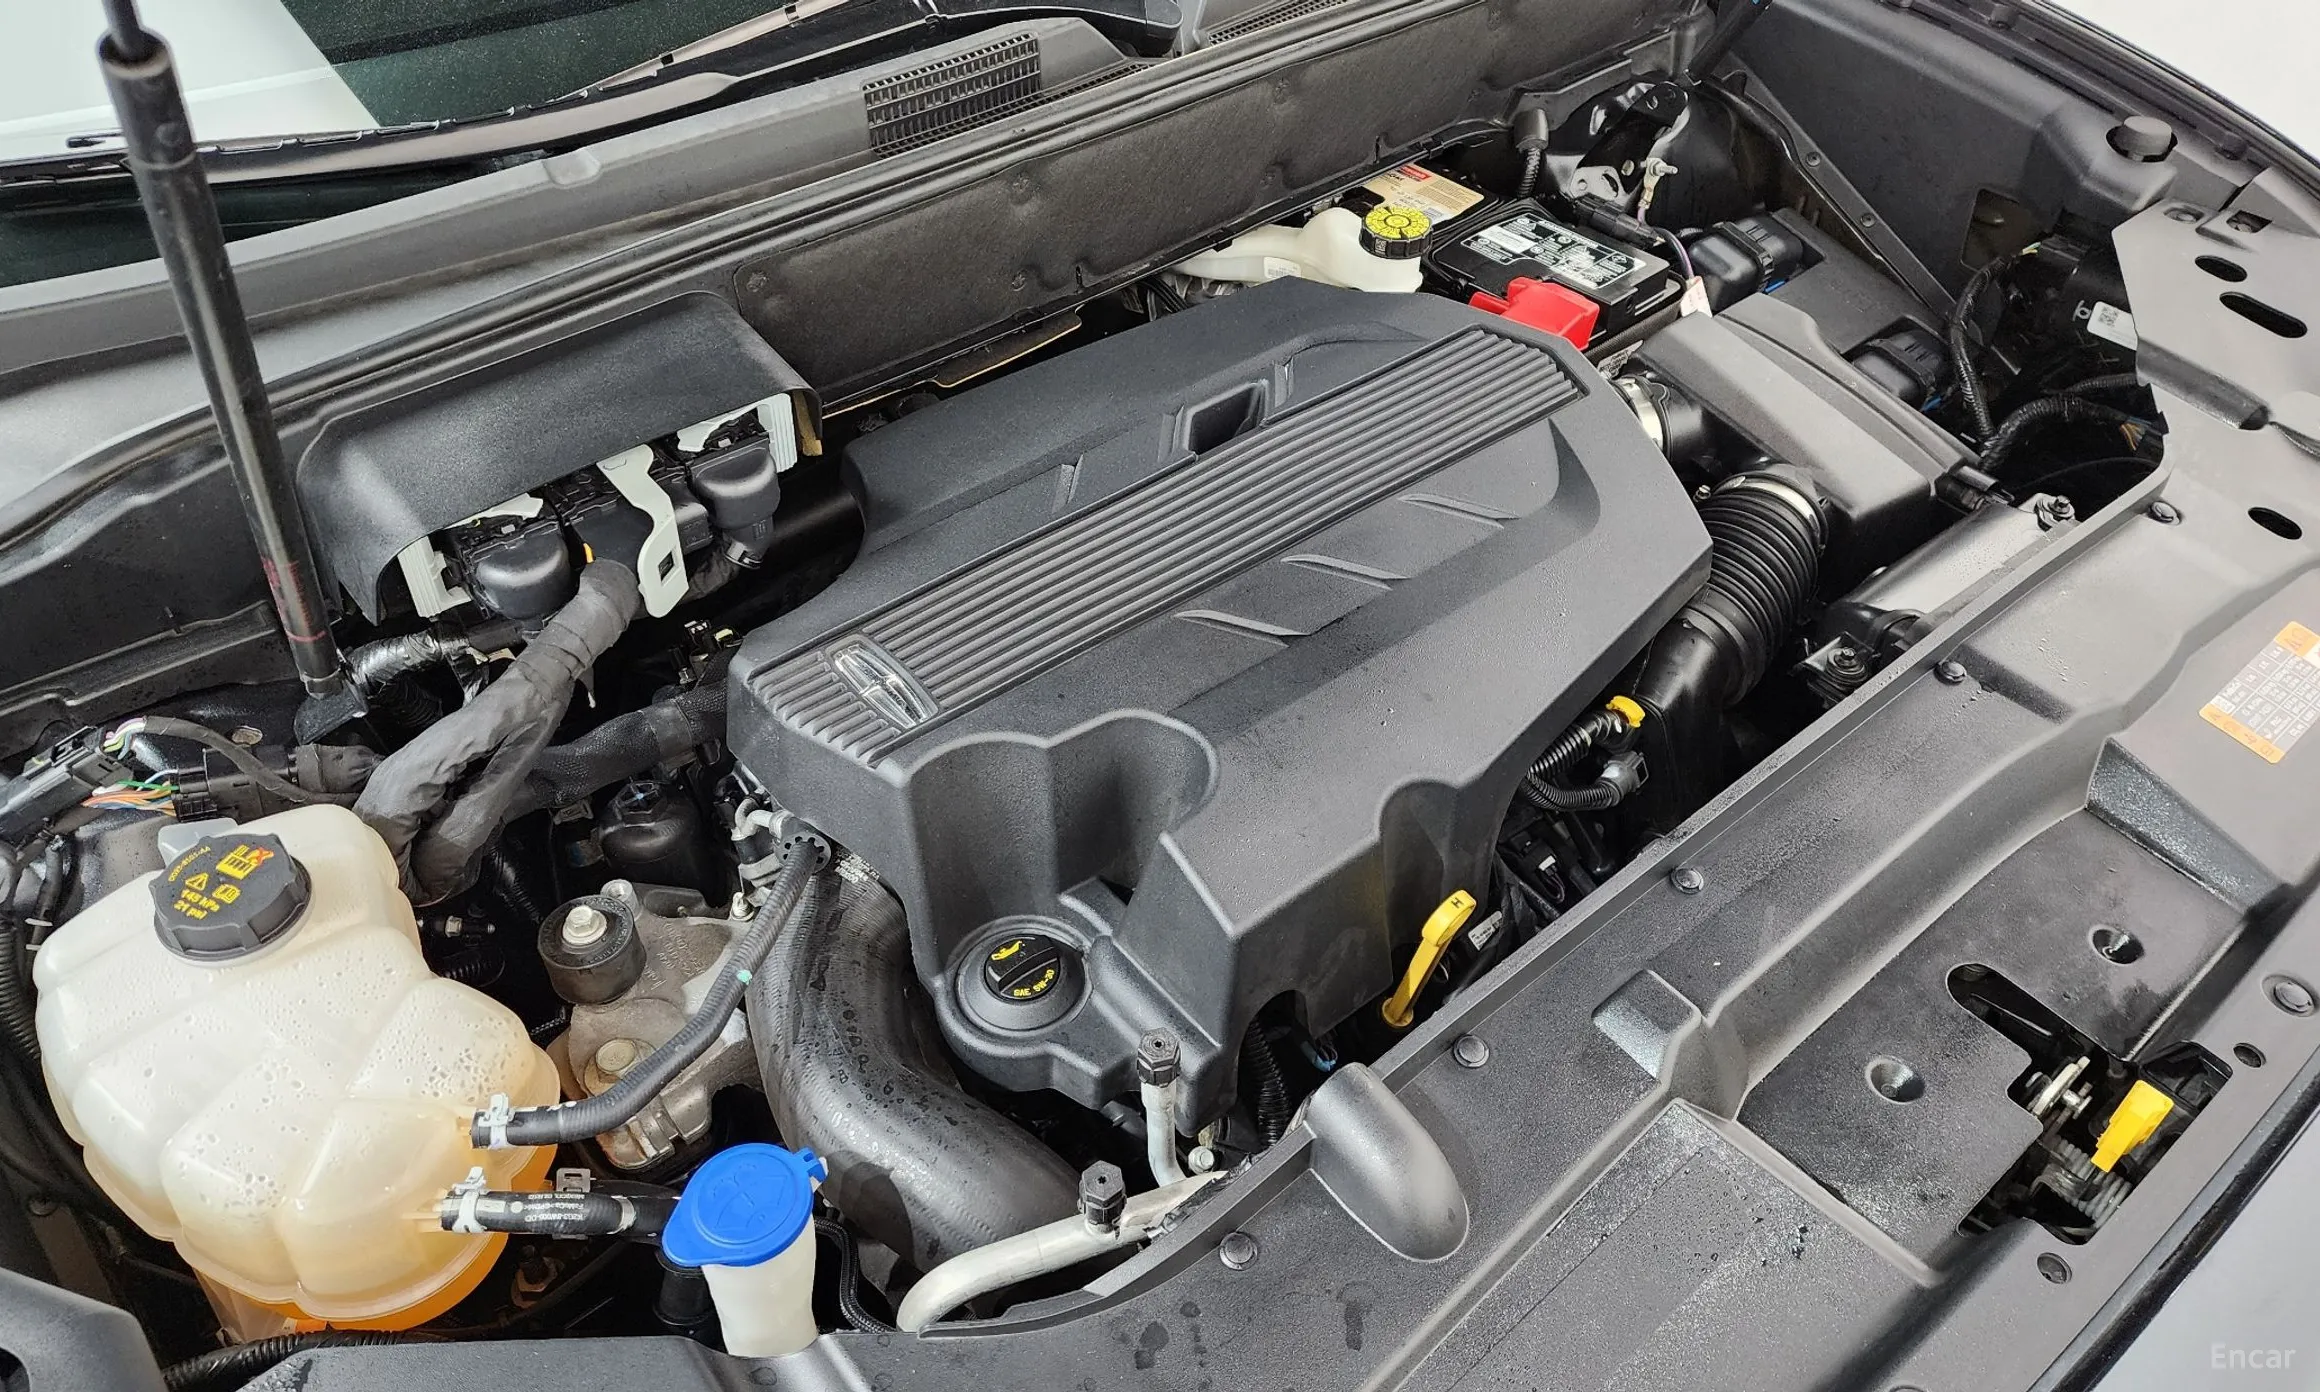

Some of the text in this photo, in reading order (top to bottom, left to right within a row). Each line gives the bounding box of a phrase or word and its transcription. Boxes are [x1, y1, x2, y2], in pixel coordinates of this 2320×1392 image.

[173, 899, 208, 920] 21 psi
[181, 889, 220, 912] 145 kPa
[1013, 988, 1032, 997] SAE
